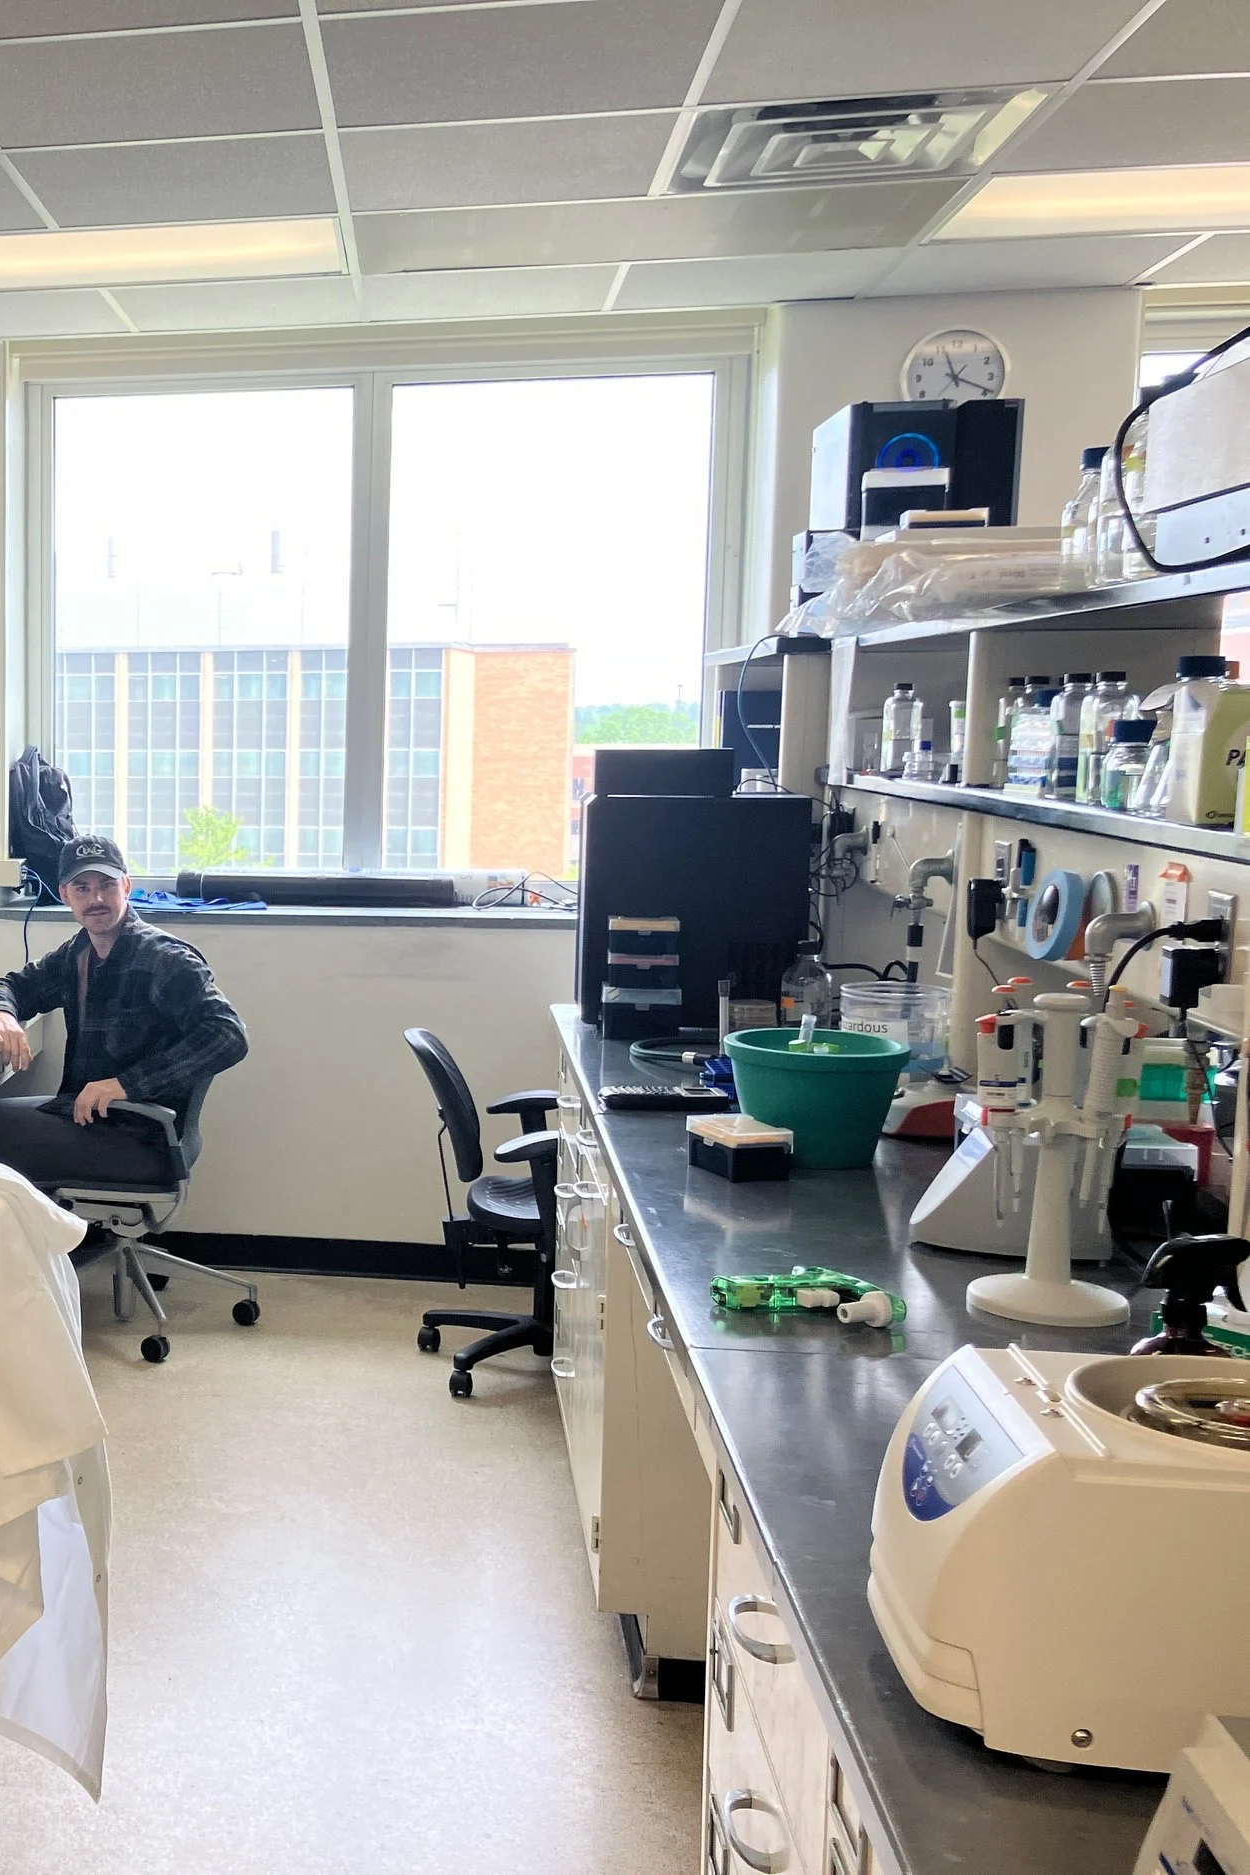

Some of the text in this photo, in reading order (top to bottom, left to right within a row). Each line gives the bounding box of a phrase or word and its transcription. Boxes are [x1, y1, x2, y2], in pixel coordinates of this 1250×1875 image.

[951, 340, 964, 349] 12
[922, 358, 934, 367] 10
[983, 356, 991, 365] 2
[915, 374, 922, 383] 9
[987, 372, 994, 381] 3
[918, 390, 926, 399] 8
